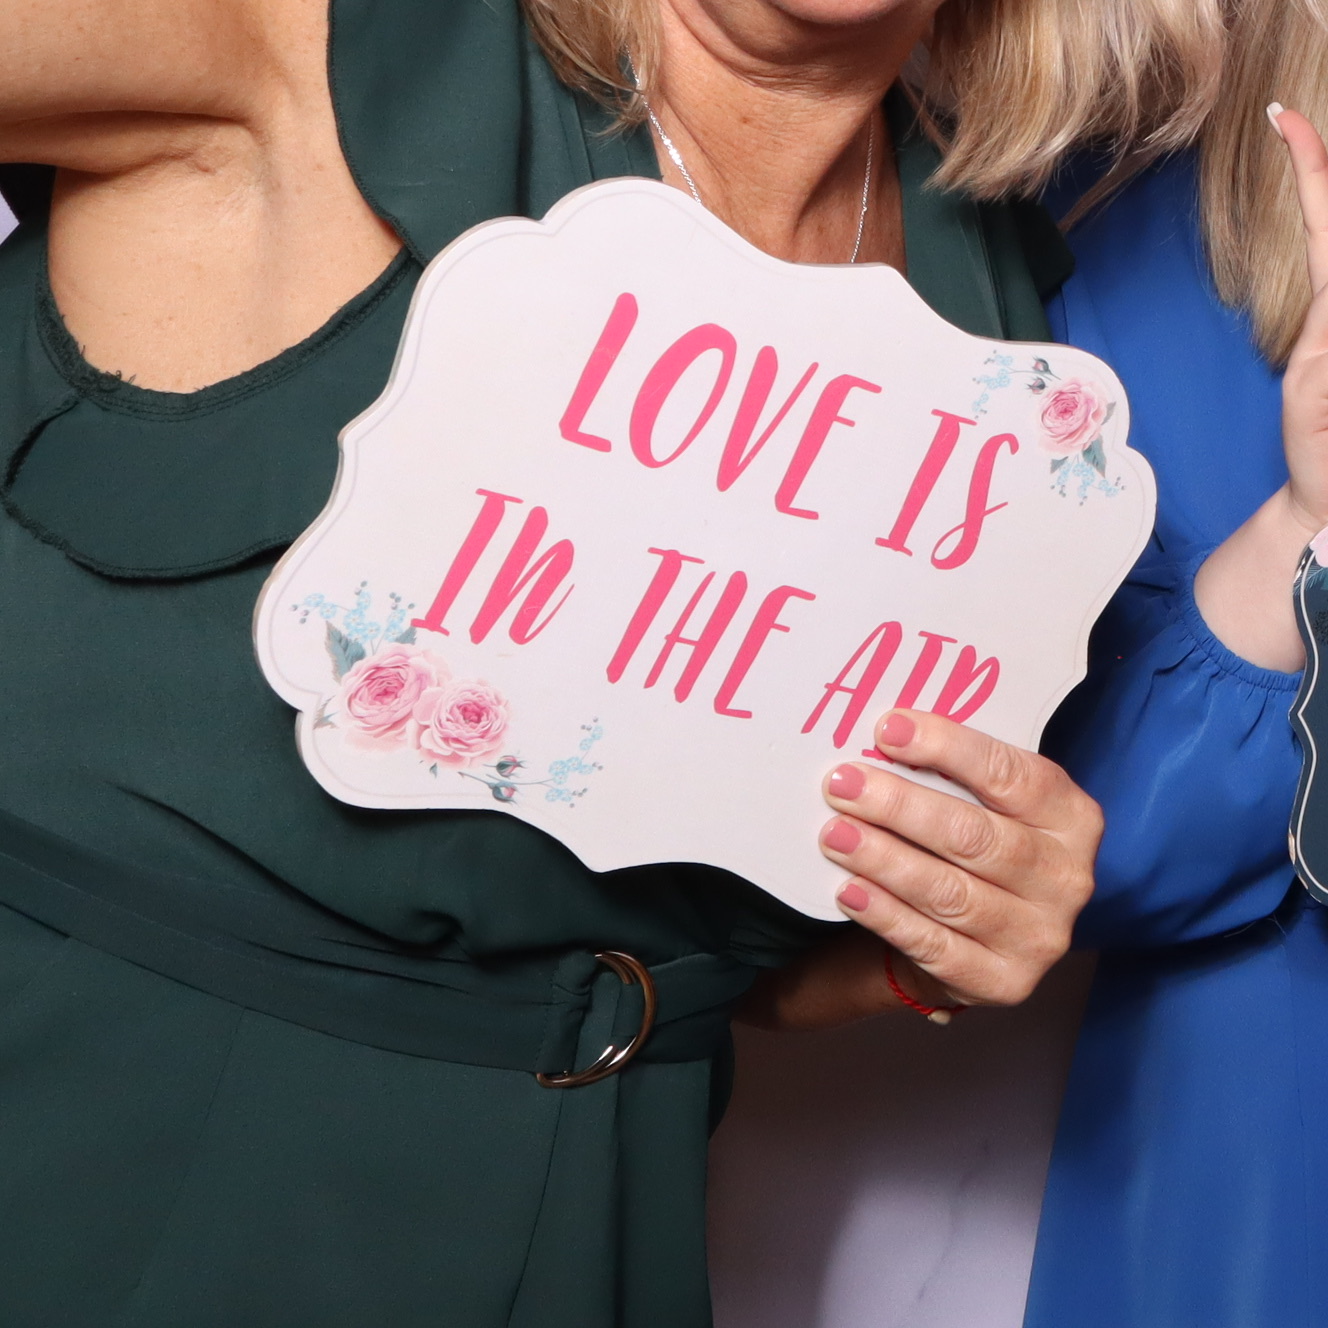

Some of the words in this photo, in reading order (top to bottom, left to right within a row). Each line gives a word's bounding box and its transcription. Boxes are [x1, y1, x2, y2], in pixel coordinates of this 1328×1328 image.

[558, 291, 883, 521] LOVE
[875, 408, 1020, 571] IS
[410, 487, 575, 646] IN
[606, 546, 817, 720] THE
